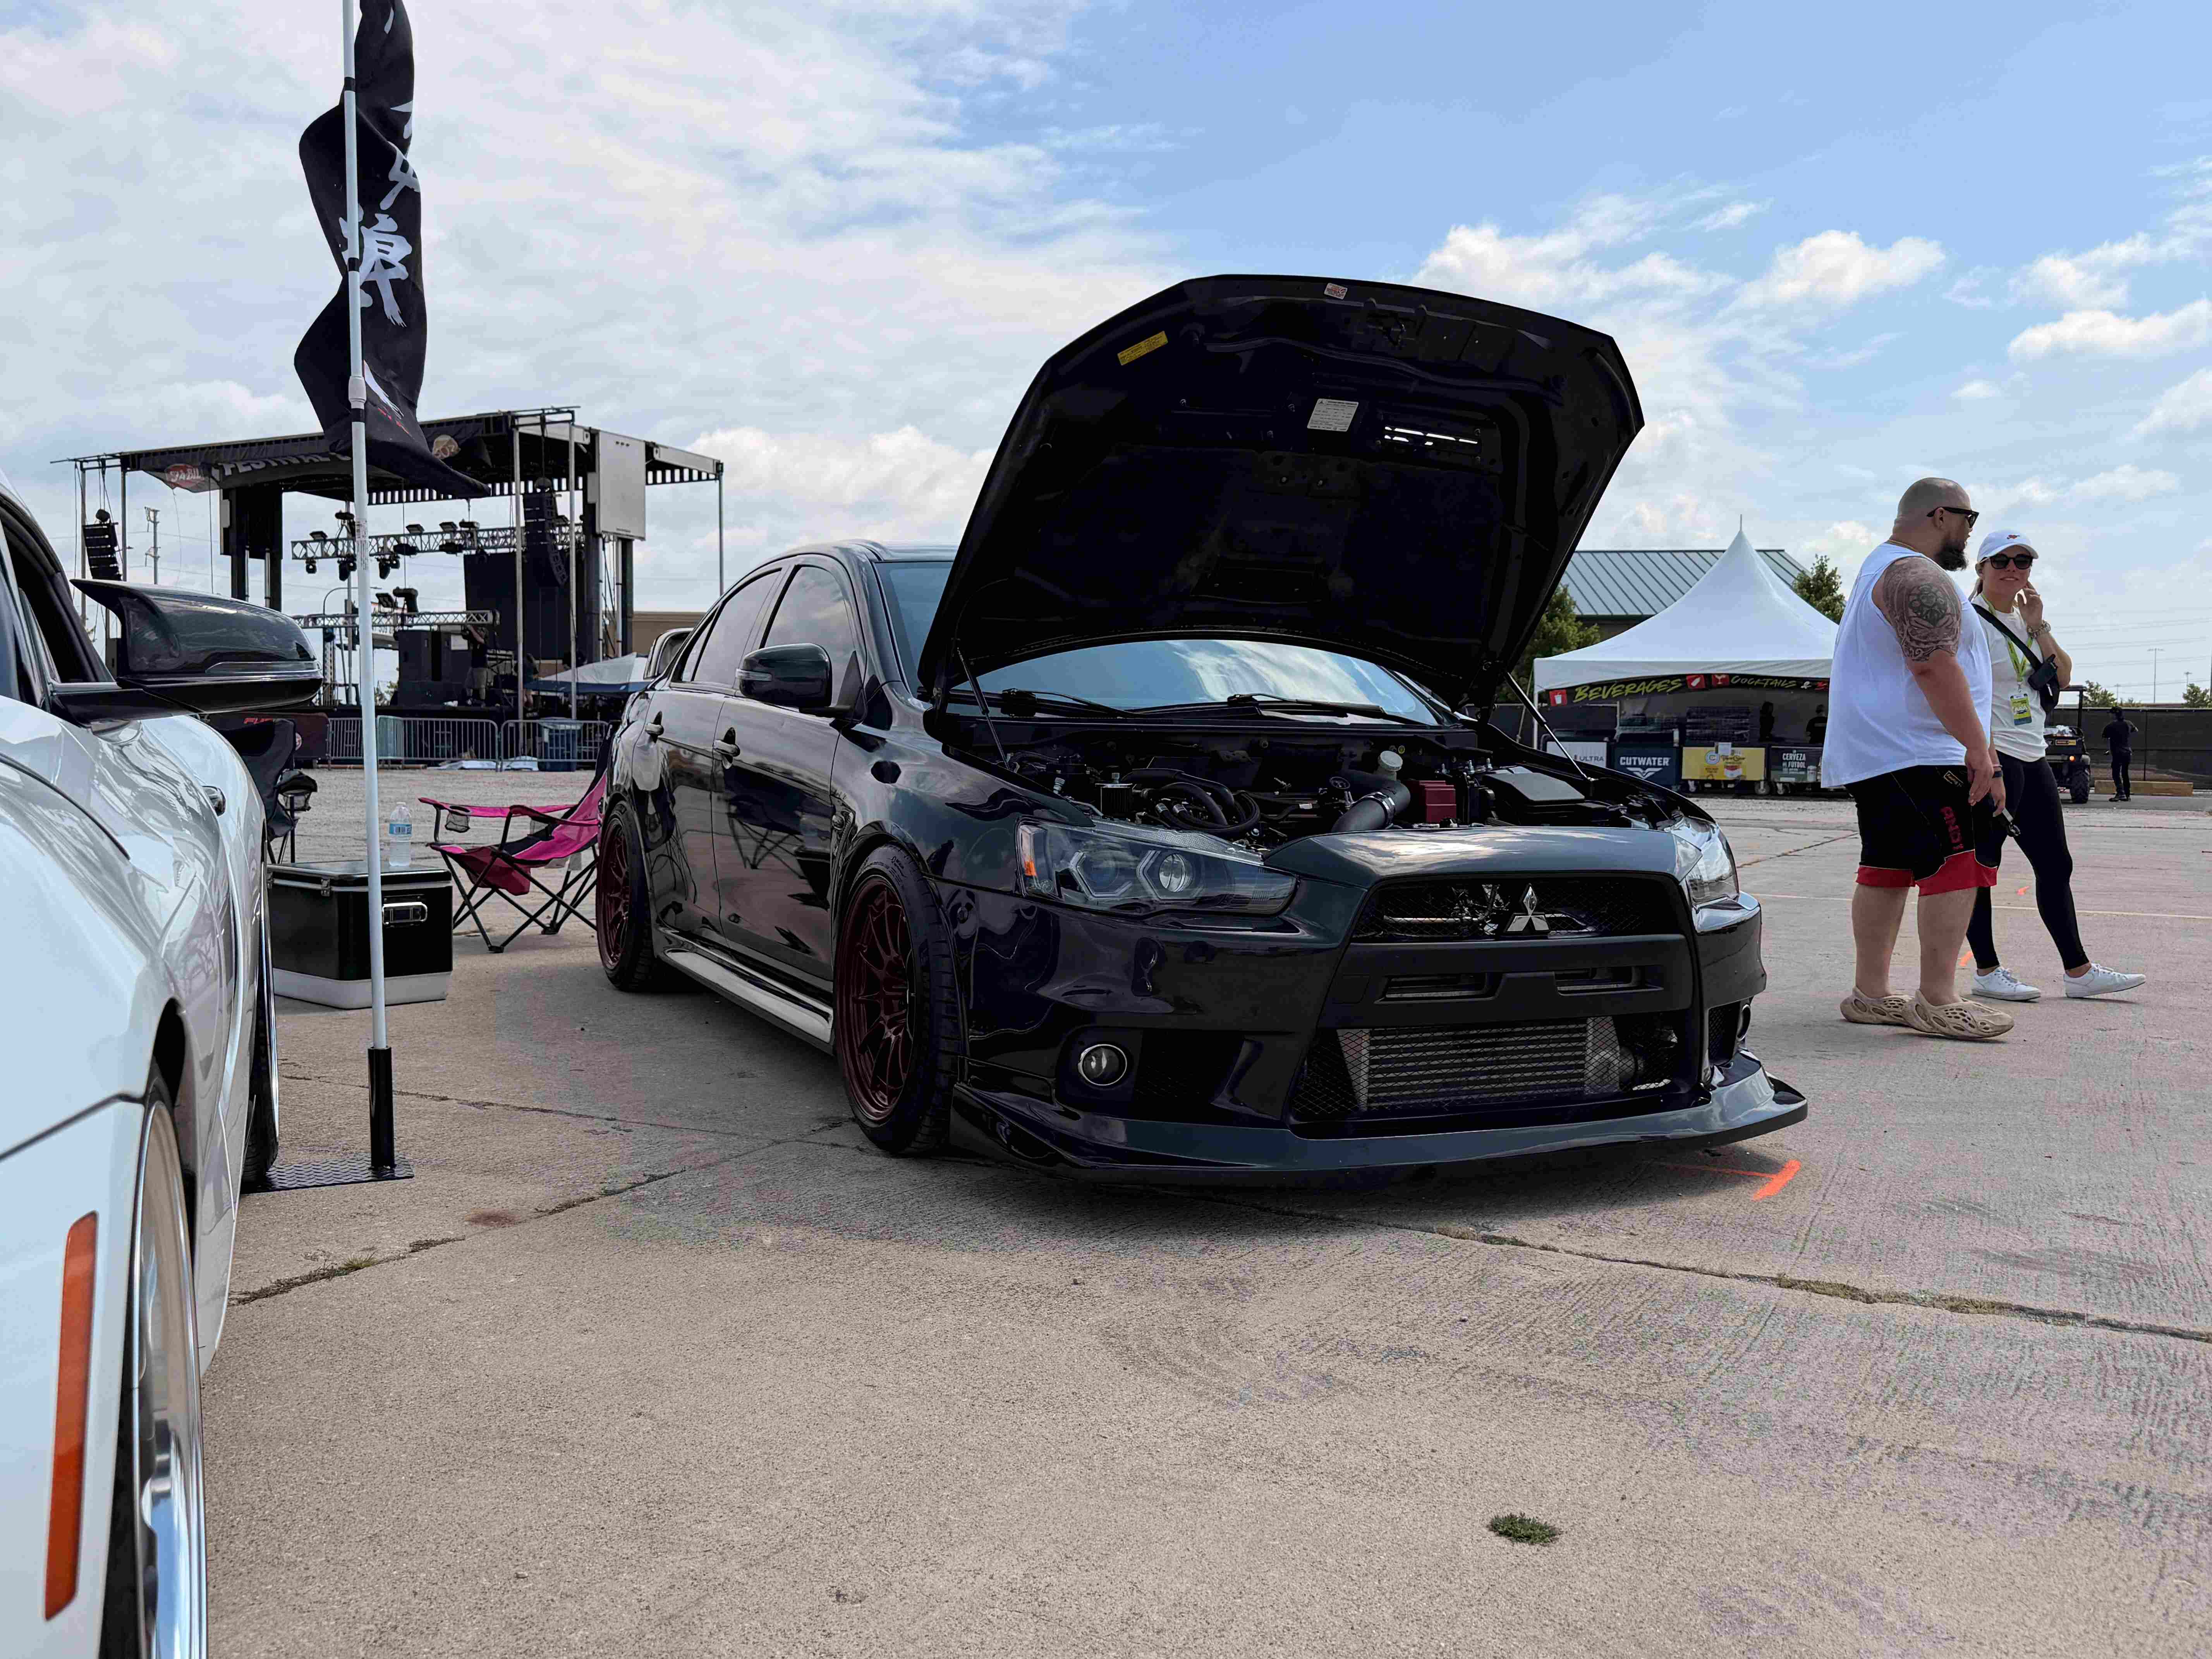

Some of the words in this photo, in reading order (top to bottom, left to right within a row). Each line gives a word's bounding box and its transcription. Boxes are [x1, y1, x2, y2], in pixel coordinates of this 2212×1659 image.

[1731, 675, 1797, 688] COCKTAILS
[1573, 678, 1682, 703] BEVERAGES
[1619, 757, 1671, 766] CUTWATER
